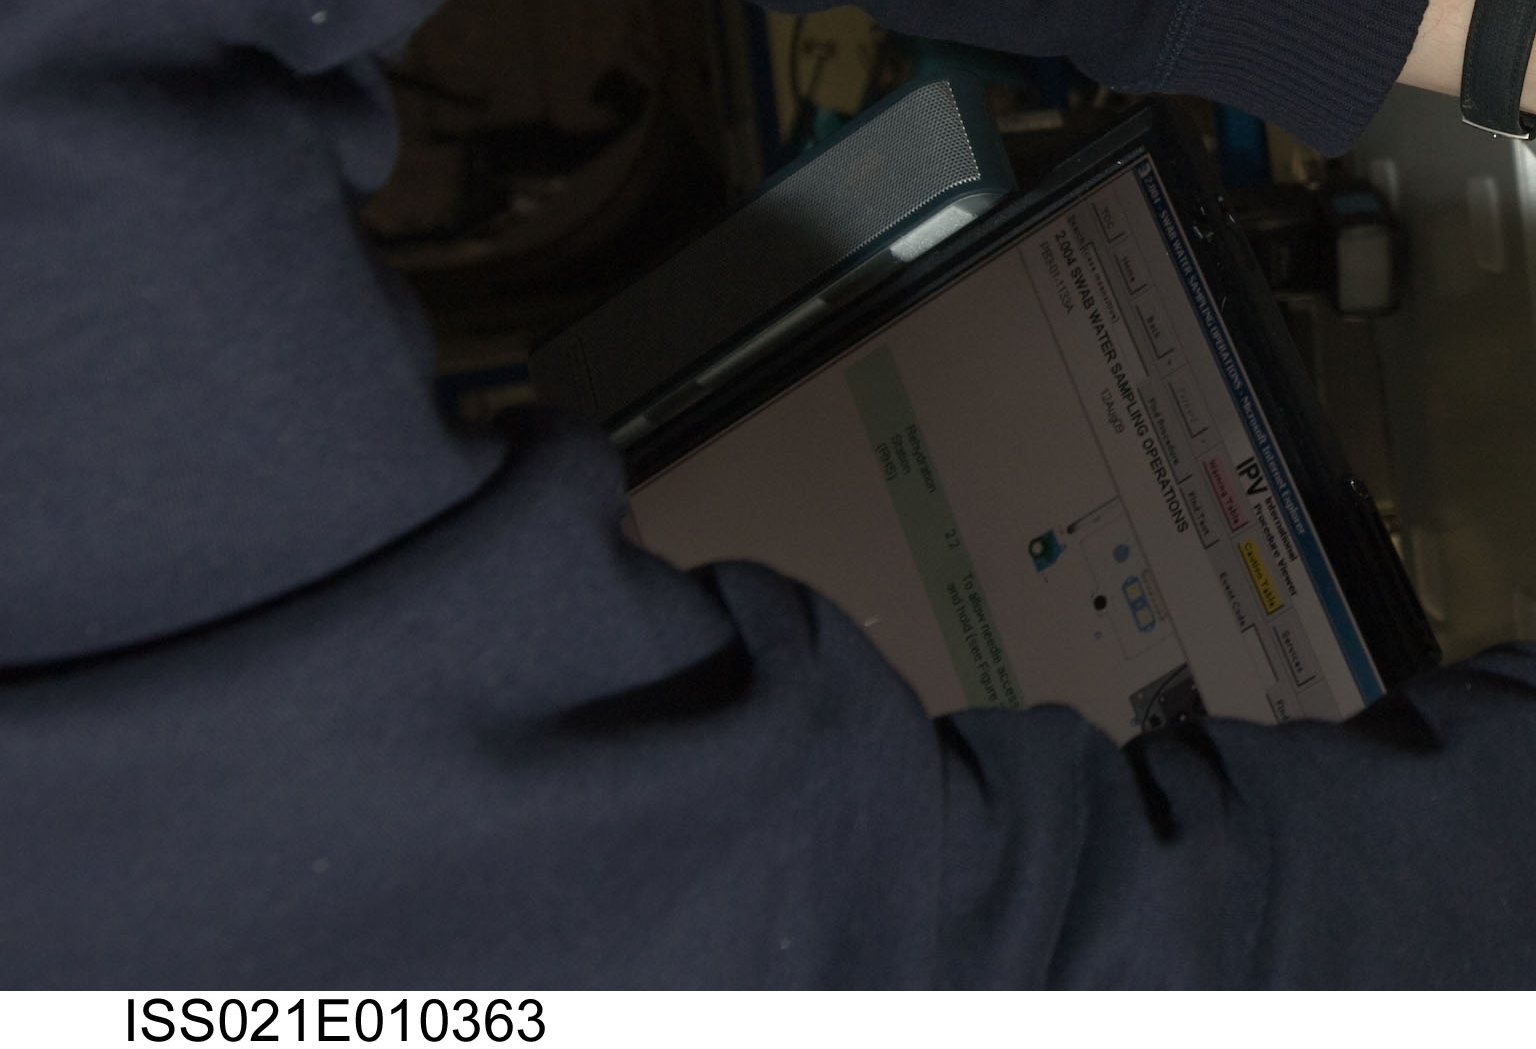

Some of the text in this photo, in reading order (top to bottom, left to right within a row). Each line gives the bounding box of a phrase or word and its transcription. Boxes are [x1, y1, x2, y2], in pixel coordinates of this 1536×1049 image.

[1053, 230, 1189, 534] 2.004 SWAB WATER SAMPLING OPERATIONS
[1171, 238, 1194, 276] WATER
[1186, 274, 1216, 327] SAMPLING
[1208, 325, 1244, 390] OPERATIONS
[1240, 395, 1269, 446] Microsoft
[1261, 445, 1288, 490] Internet
[1279, 489, 1307, 537] Explorer
[1233, 456, 1268, 498] IPV
[1224, 498, 1241, 524] Table
[1263, 496, 1298, 562] International
[959, 572, 977, 591] To
[1242, 541, 1277, 607] Caution Table
[1252, 502, 1298, 597] Procedure Viewer
